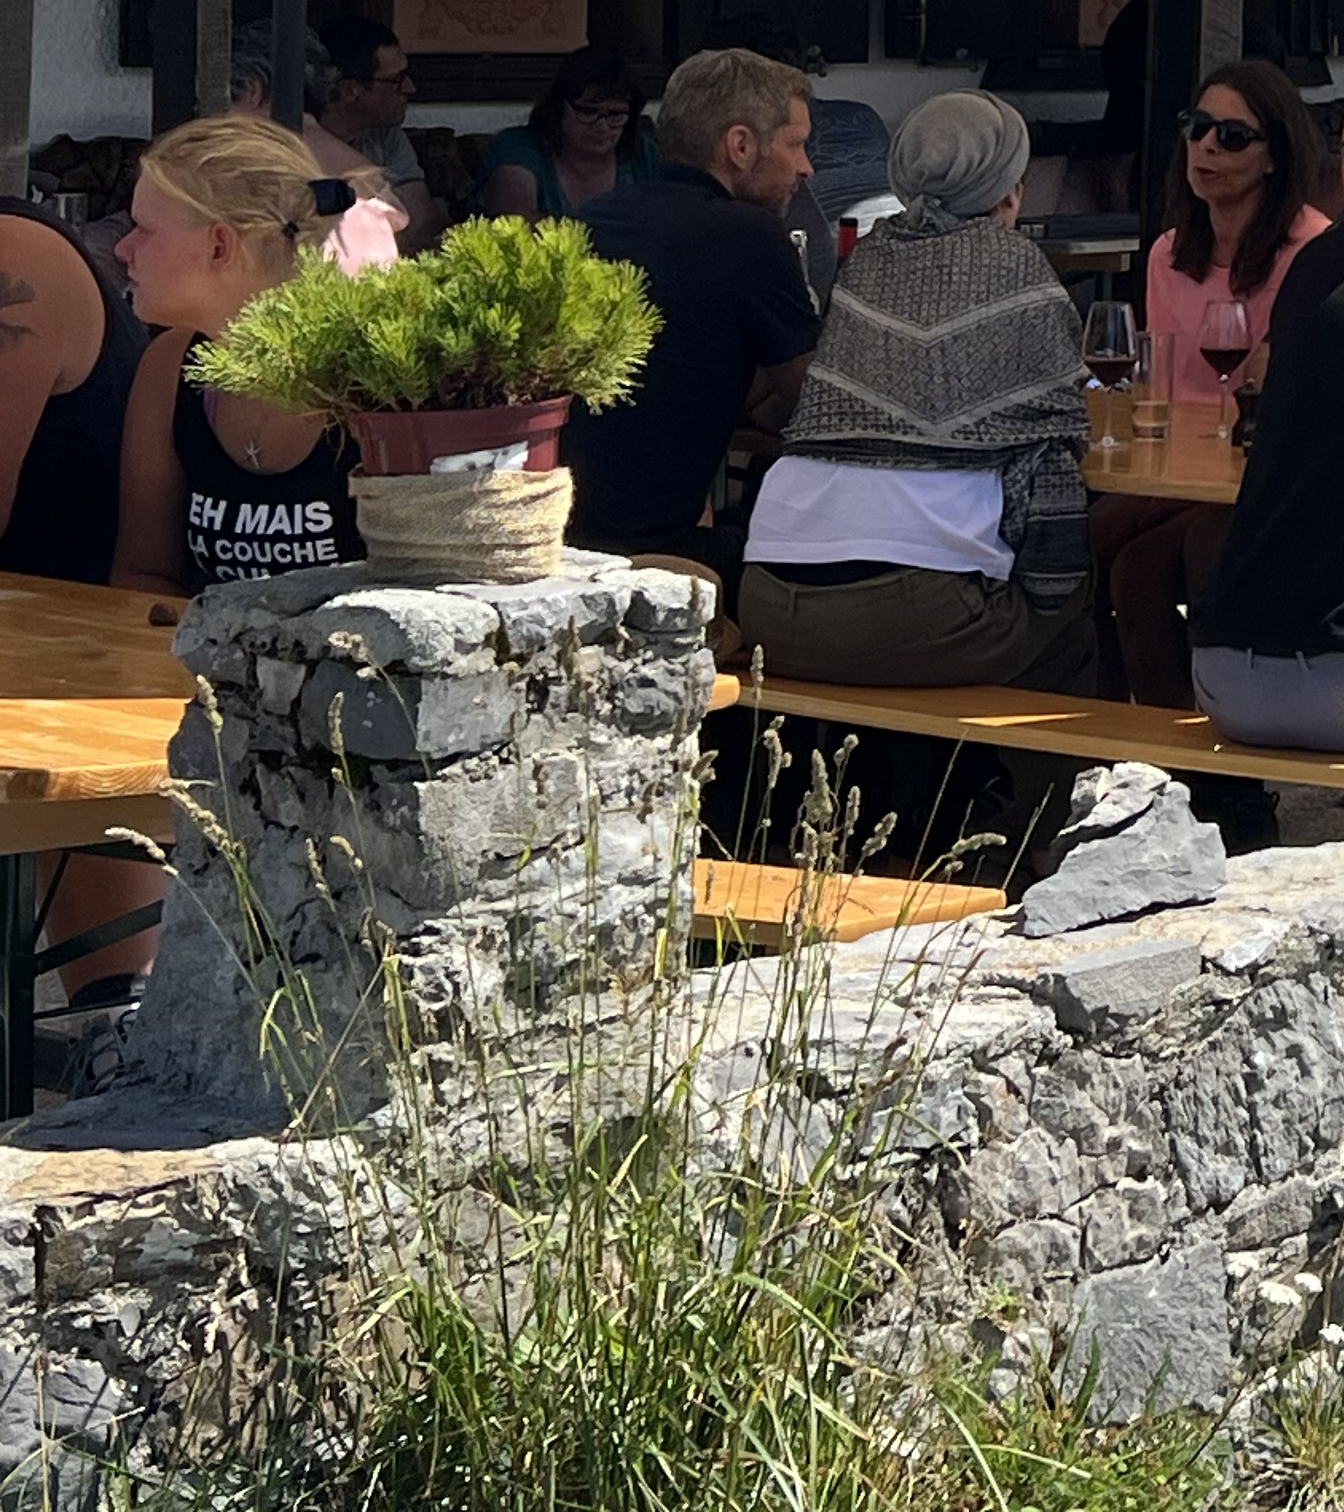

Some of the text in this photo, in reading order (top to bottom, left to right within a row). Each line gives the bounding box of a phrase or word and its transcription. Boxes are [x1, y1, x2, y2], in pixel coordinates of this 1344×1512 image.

[189, 492, 333, 535] EH MAIS
[215, 538, 338, 564] COUCHE
